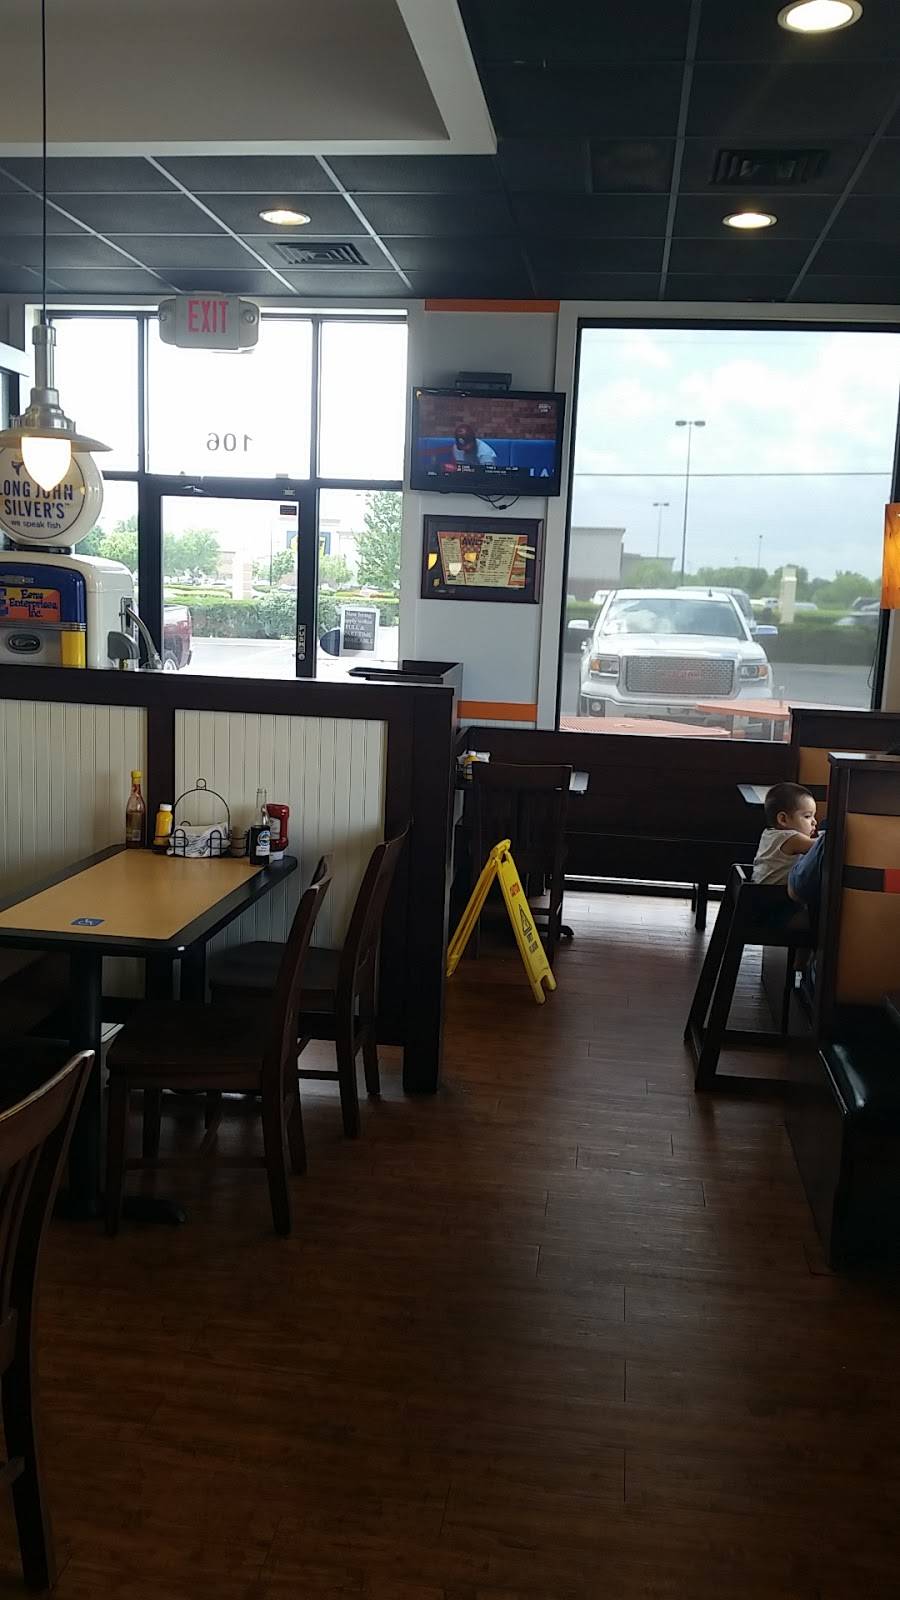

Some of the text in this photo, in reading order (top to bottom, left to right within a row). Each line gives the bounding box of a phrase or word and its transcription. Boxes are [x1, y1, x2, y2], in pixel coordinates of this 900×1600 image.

[188, 299, 229, 334] EXIT
[4, 498, 65, 519] SILVER'S
[23, 520, 45, 529] speak
[47, 521, 62, 529] fish
